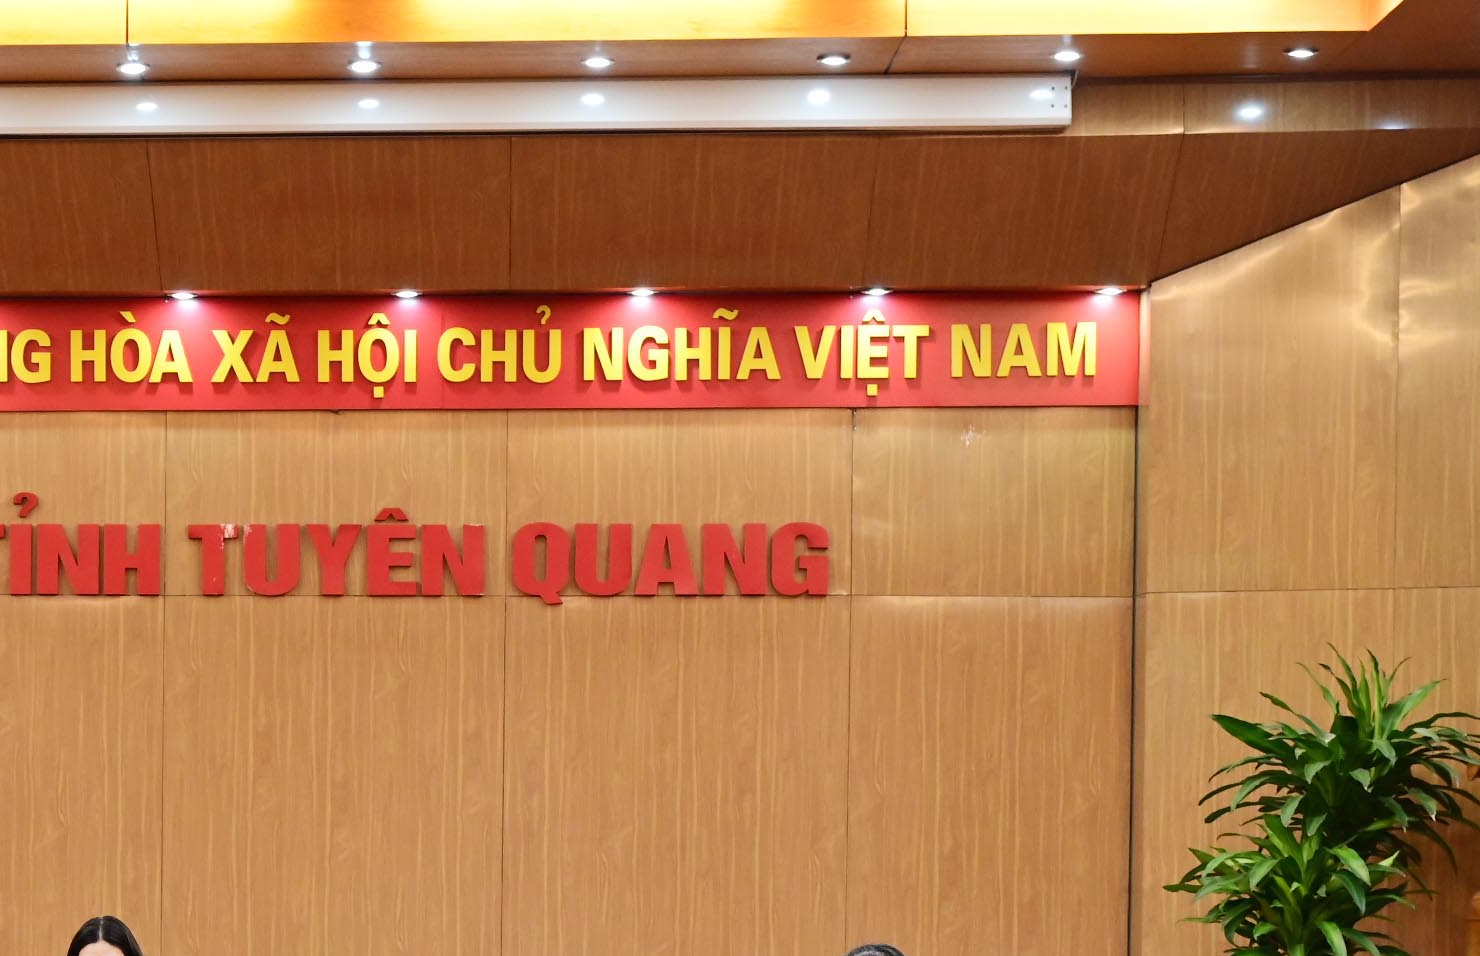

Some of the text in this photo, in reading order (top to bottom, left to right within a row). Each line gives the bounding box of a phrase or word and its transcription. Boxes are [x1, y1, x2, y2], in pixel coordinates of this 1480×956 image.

[70, 310, 194, 383] HÒA
[211, 313, 301, 383] XÃ
[317, 312, 418, 398] HỘI
[436, 304, 562, 384] CHỦ
[582, 308, 781, 382] NGHĨA
[795, 309, 930, 396] VIỆT
[950, 321, 1098, 378] NAM
[187, 506, 487, 597] TUYÊN
[510, 521, 831, 606] QUANG
